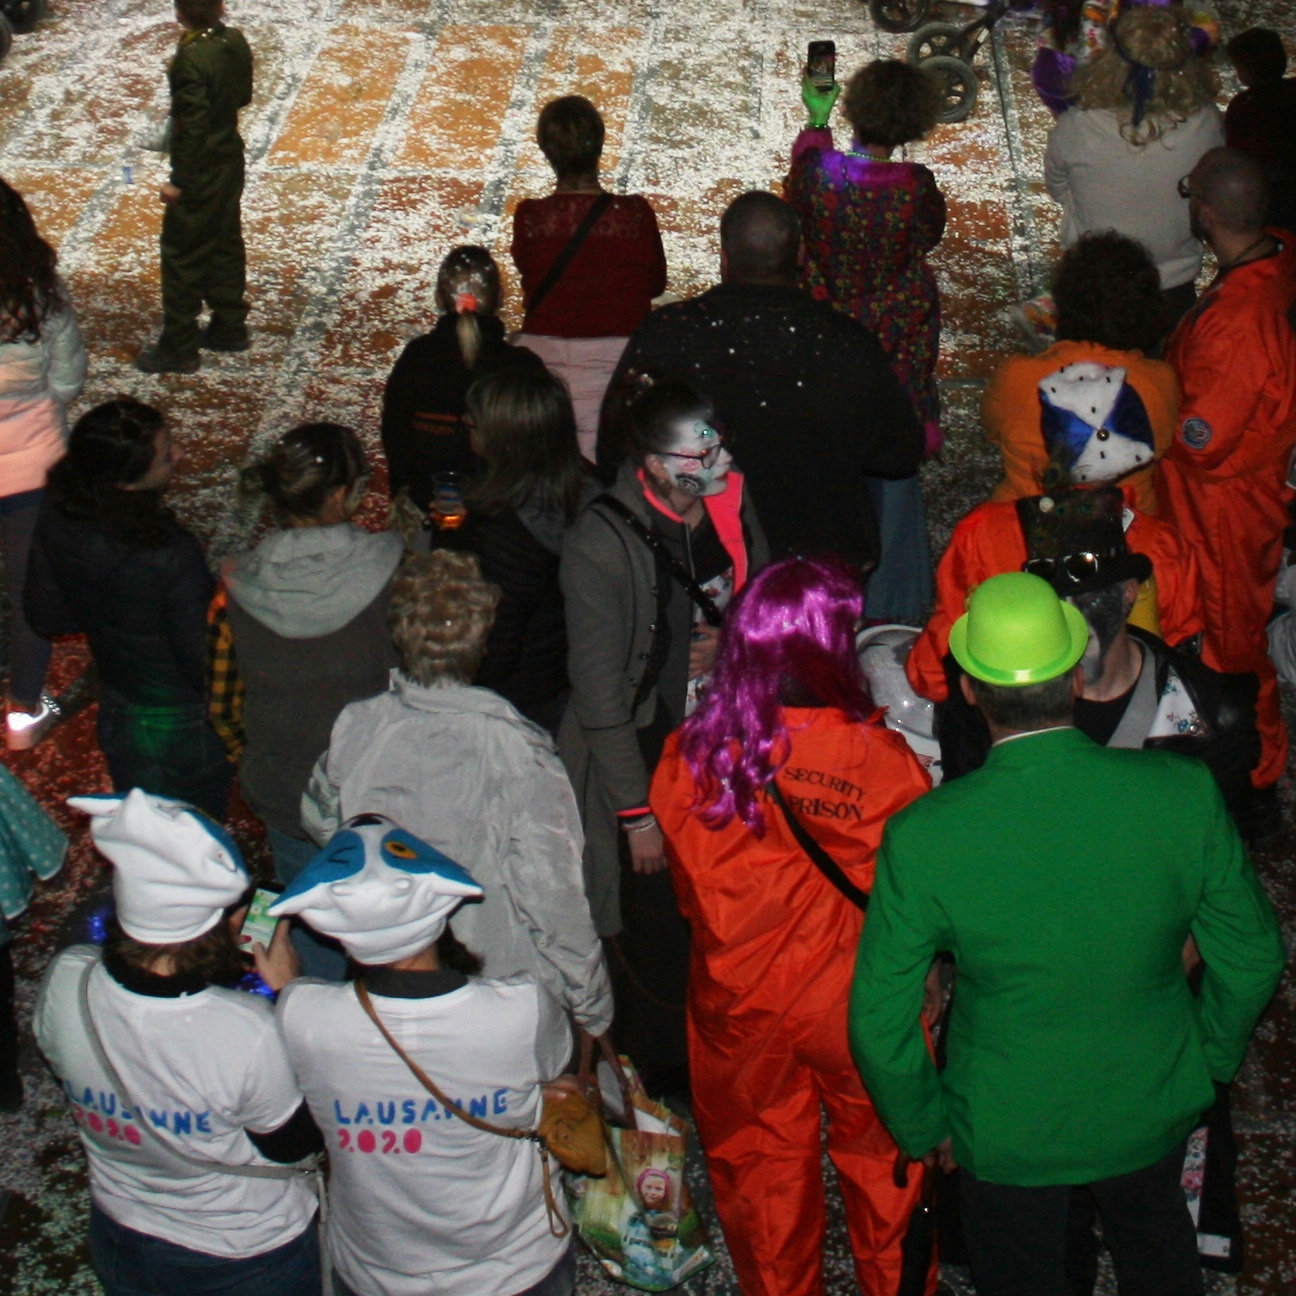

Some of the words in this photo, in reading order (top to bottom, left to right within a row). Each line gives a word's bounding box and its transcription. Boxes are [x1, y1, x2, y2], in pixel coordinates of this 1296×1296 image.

[784, 766, 866, 802] SECURITY
[787, 793, 863, 822] PRISON
[337, 1127, 423, 1154] 2020
